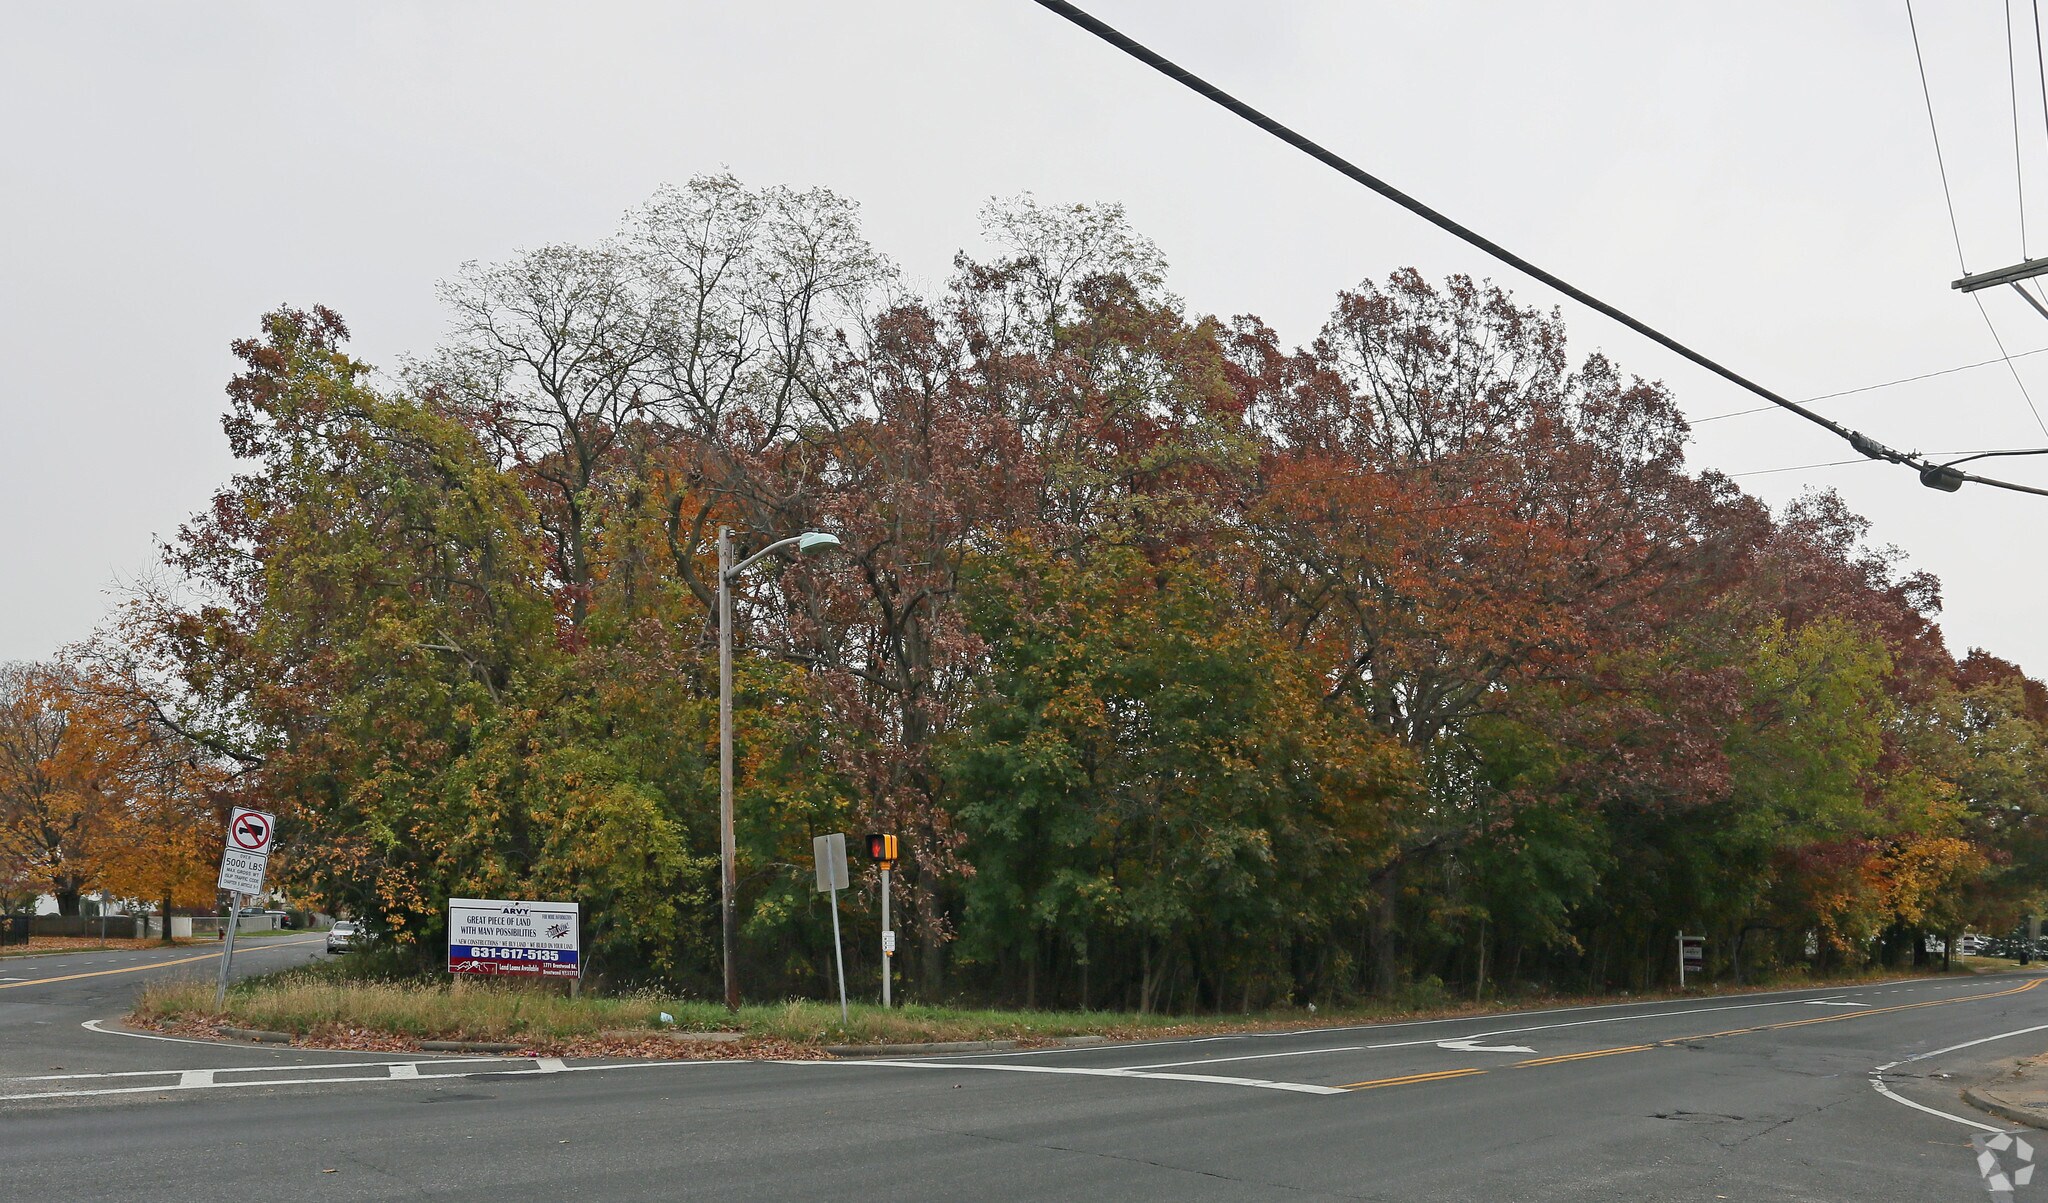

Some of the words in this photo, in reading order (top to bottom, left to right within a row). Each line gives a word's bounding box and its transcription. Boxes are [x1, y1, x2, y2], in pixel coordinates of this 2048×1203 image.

[226, 858, 246, 868] 5000
[249, 862, 262, 872] LBS
[467, 916, 486, 924] GREAT
[488, 916, 505, 925] PIECE
[516, 918, 531, 926] LAND
[460, 926, 476, 934] WITH
[478, 927, 494, 935] MANY
[496, 928, 536, 938] POSSIBILITIES
[471, 947, 559, 961] 631-617-5135
